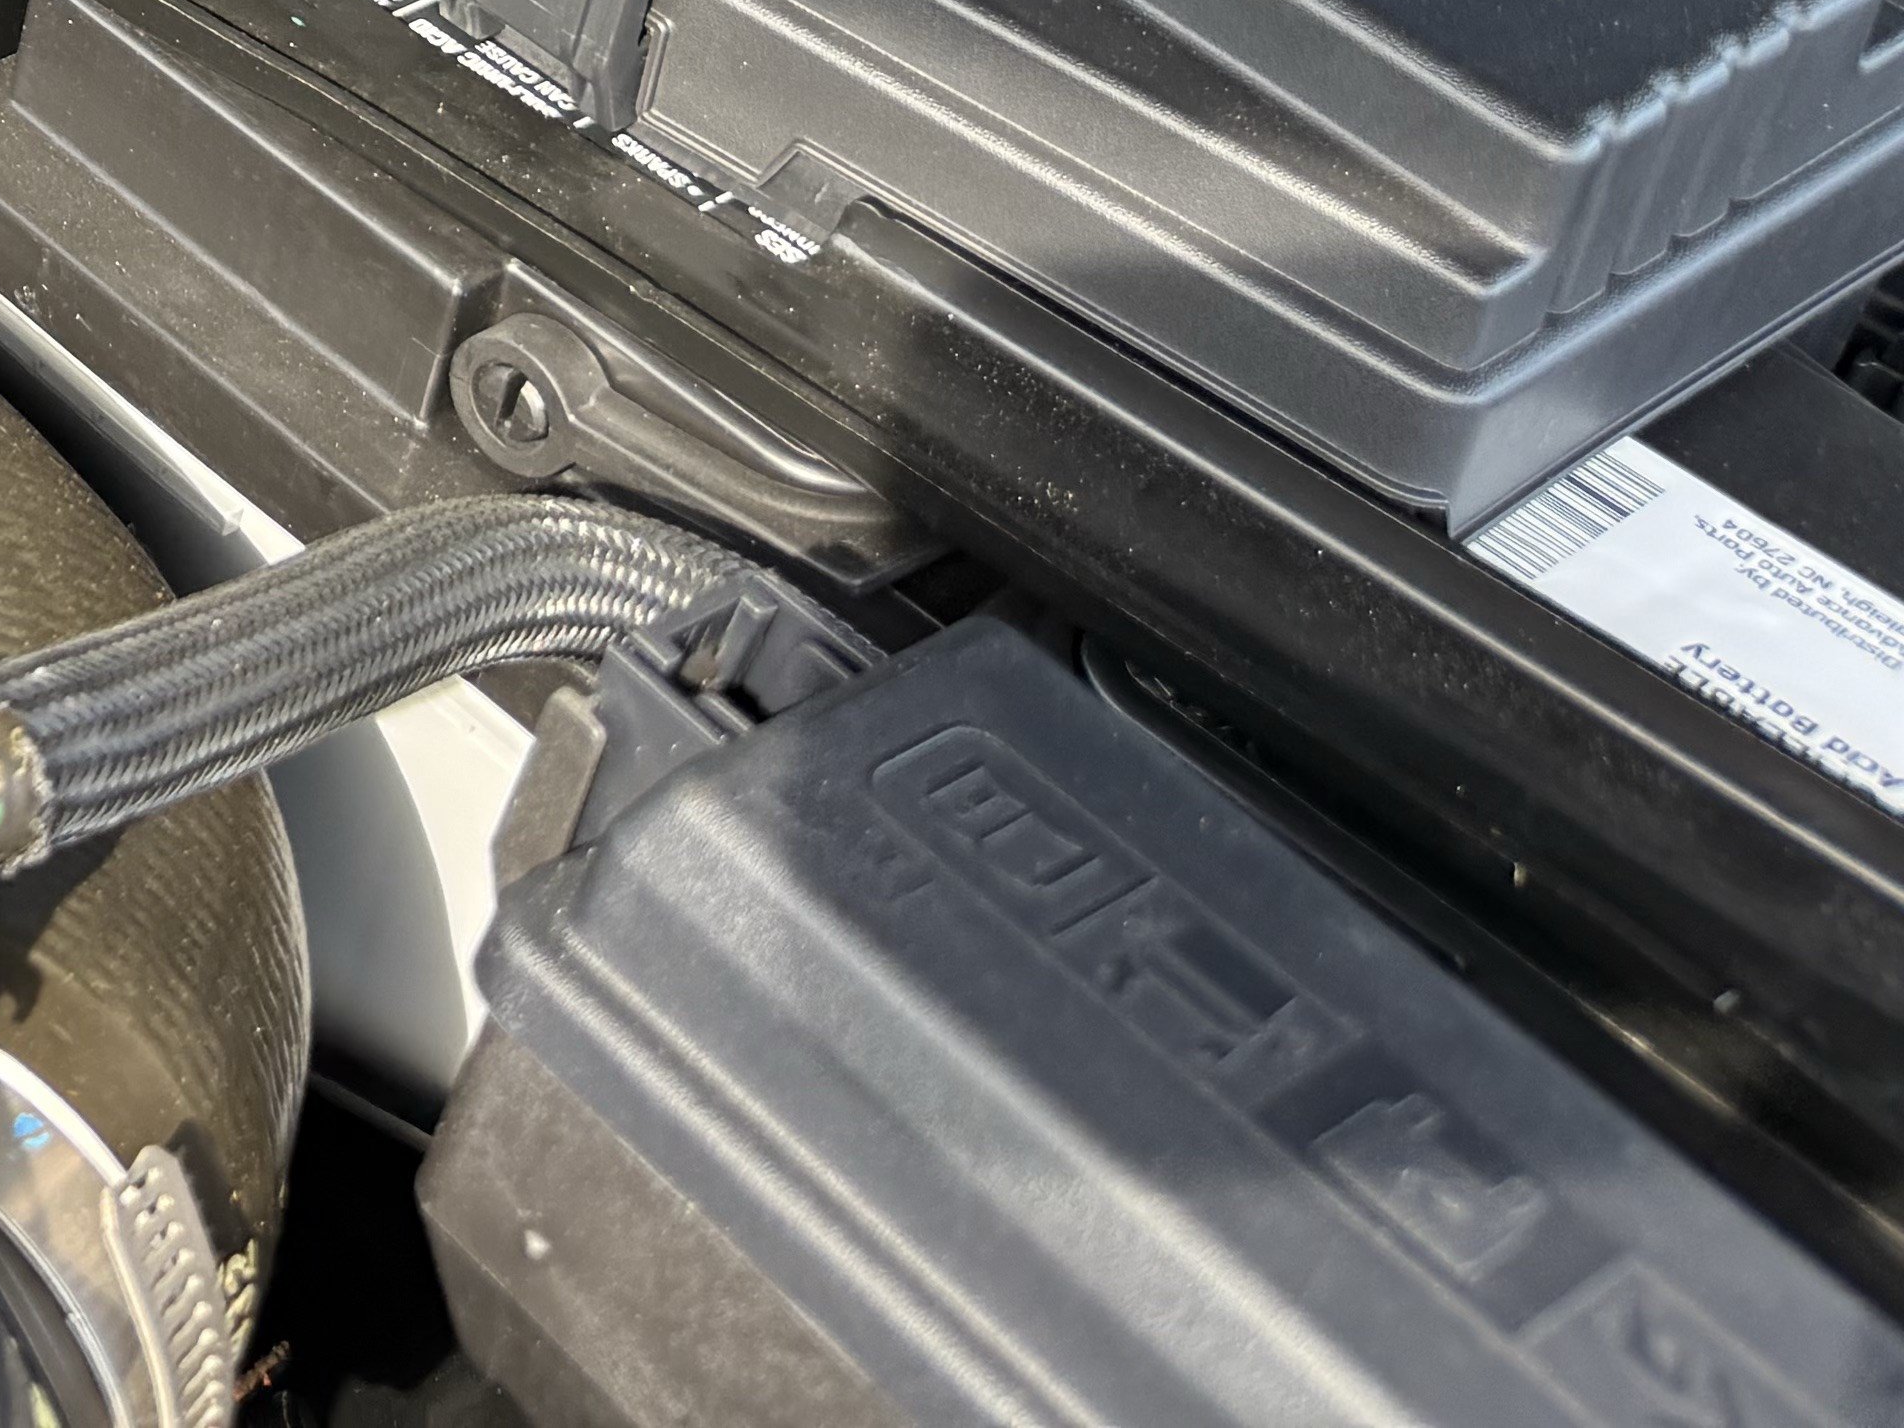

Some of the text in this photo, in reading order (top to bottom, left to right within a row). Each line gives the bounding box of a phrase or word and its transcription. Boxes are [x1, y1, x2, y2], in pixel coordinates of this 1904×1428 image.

[408, 18, 468, 54] ACID
[474, 39, 579, 111] CAN CAUSE
[612, 133, 693, 188] SPARKS
[1722, 519, 1797, 567] 27604
[1758, 558, 1814, 594] Auto
[1798, 565, 1834, 590] NC
[1771, 587, 1903, 671] Distributed
[1680, 642, 1819, 737] Battery
[1822, 735, 1904, 788] Acid
